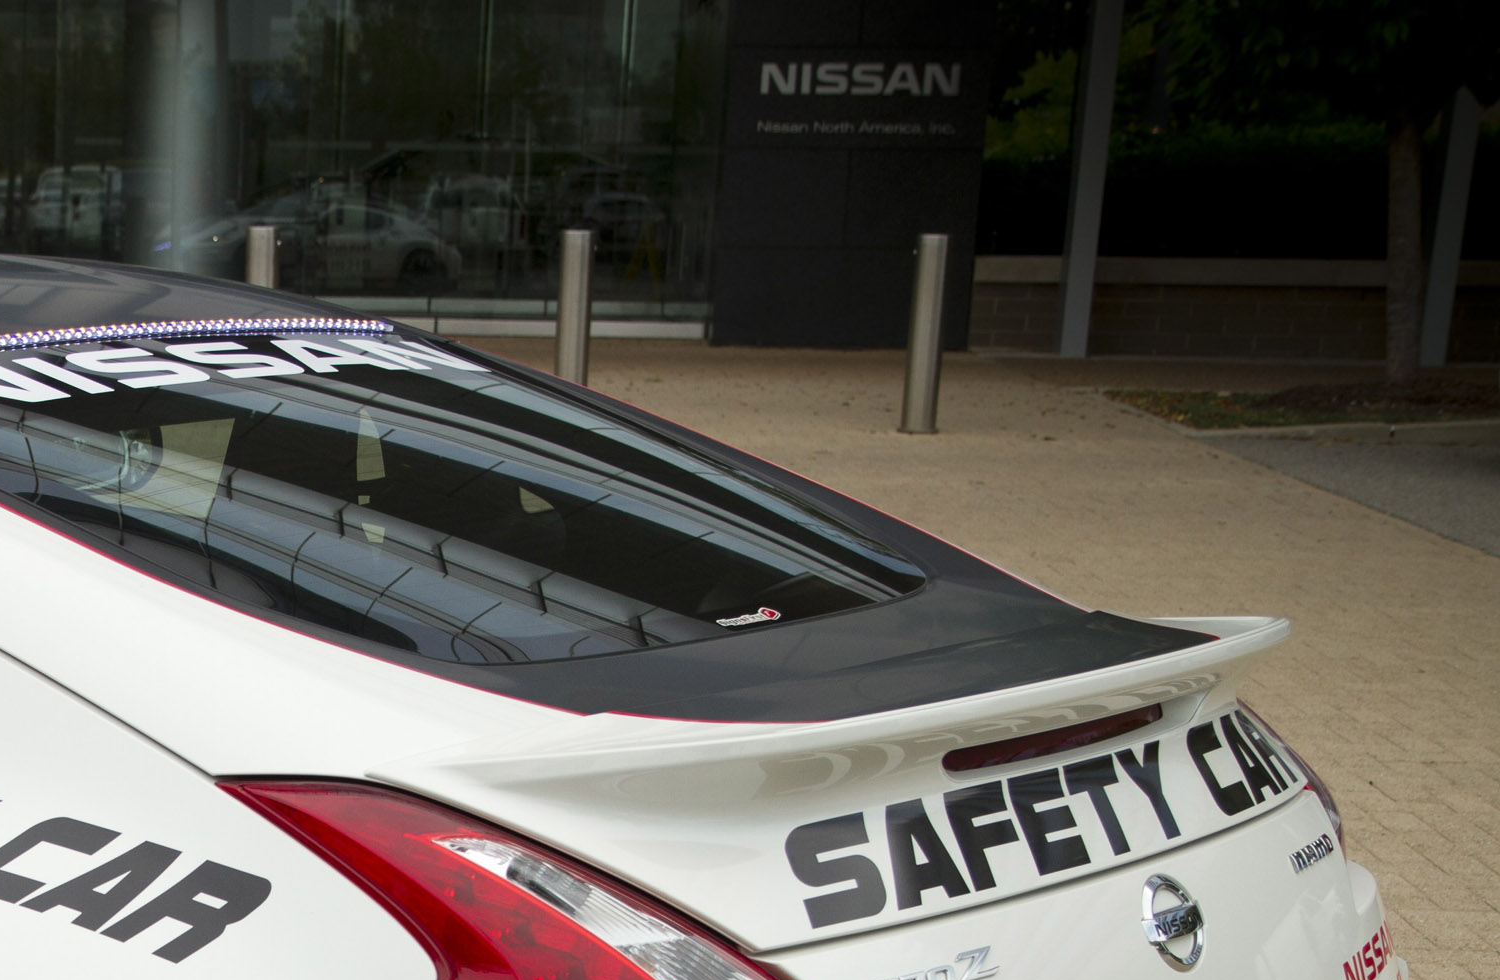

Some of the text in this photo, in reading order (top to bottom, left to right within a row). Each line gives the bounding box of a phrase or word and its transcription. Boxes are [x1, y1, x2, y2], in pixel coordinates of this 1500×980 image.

[760, 62, 962, 97] NISSAN
[756, 120, 809, 134] Nissan
[813, 120, 854, 134] North
[784, 708, 1299, 929] SAFETY CAR
